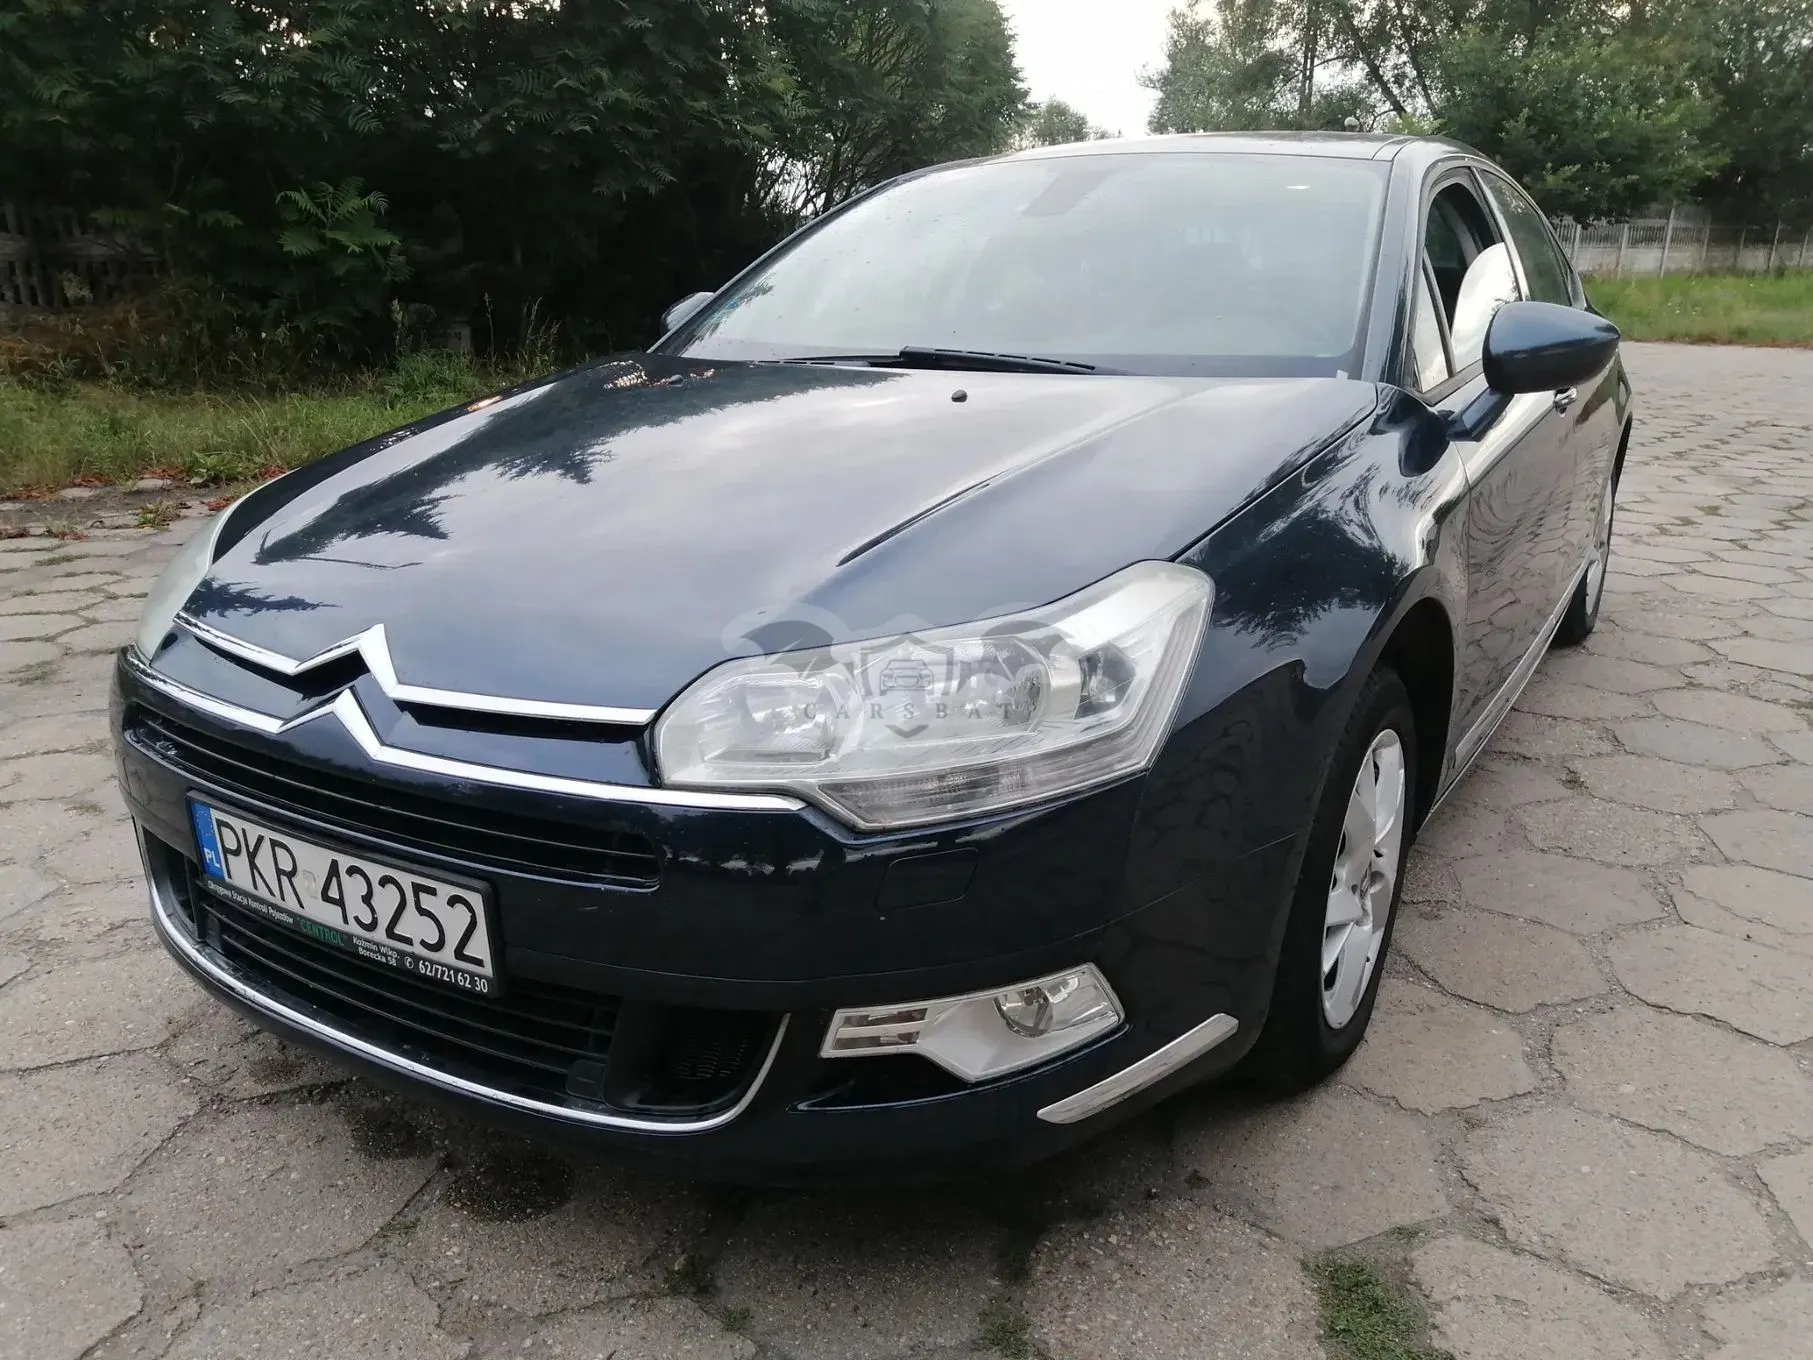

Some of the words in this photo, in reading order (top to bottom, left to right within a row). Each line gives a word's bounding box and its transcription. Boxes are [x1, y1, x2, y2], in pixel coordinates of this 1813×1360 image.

[204, 847, 221, 868] PL
[216, 817, 304, 909] PKR
[321, 858, 485, 968] 43252
[232, 889, 248, 905] Stacja
[248, 897, 268, 912] Kontroli
[358, 946, 386, 963] Borecka
[419, 960, 455, 983] 62/721
[457, 971, 471, 988] 62
[474, 976, 488, 993] 30
